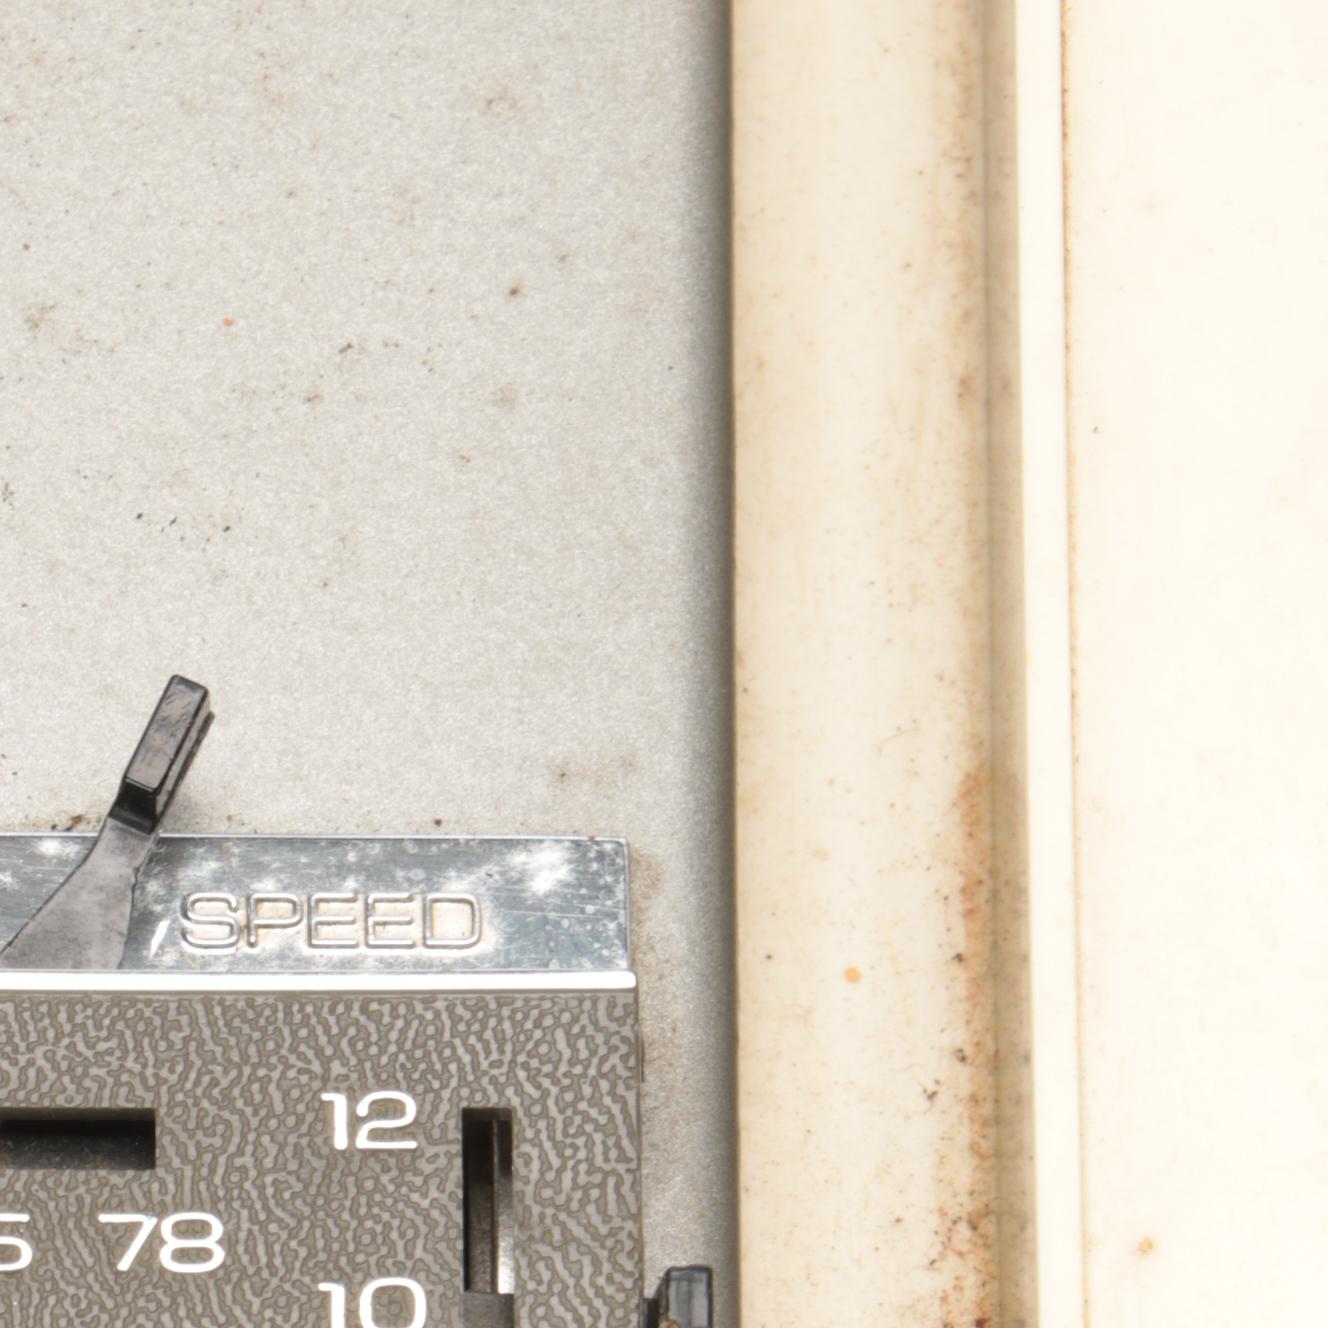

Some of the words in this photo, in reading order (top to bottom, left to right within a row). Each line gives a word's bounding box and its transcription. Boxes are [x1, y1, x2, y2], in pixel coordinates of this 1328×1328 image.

[179, 891, 483, 950] SPEED
[320, 1090, 418, 1150] 12
[98, 1211, 225, 1273] 78
